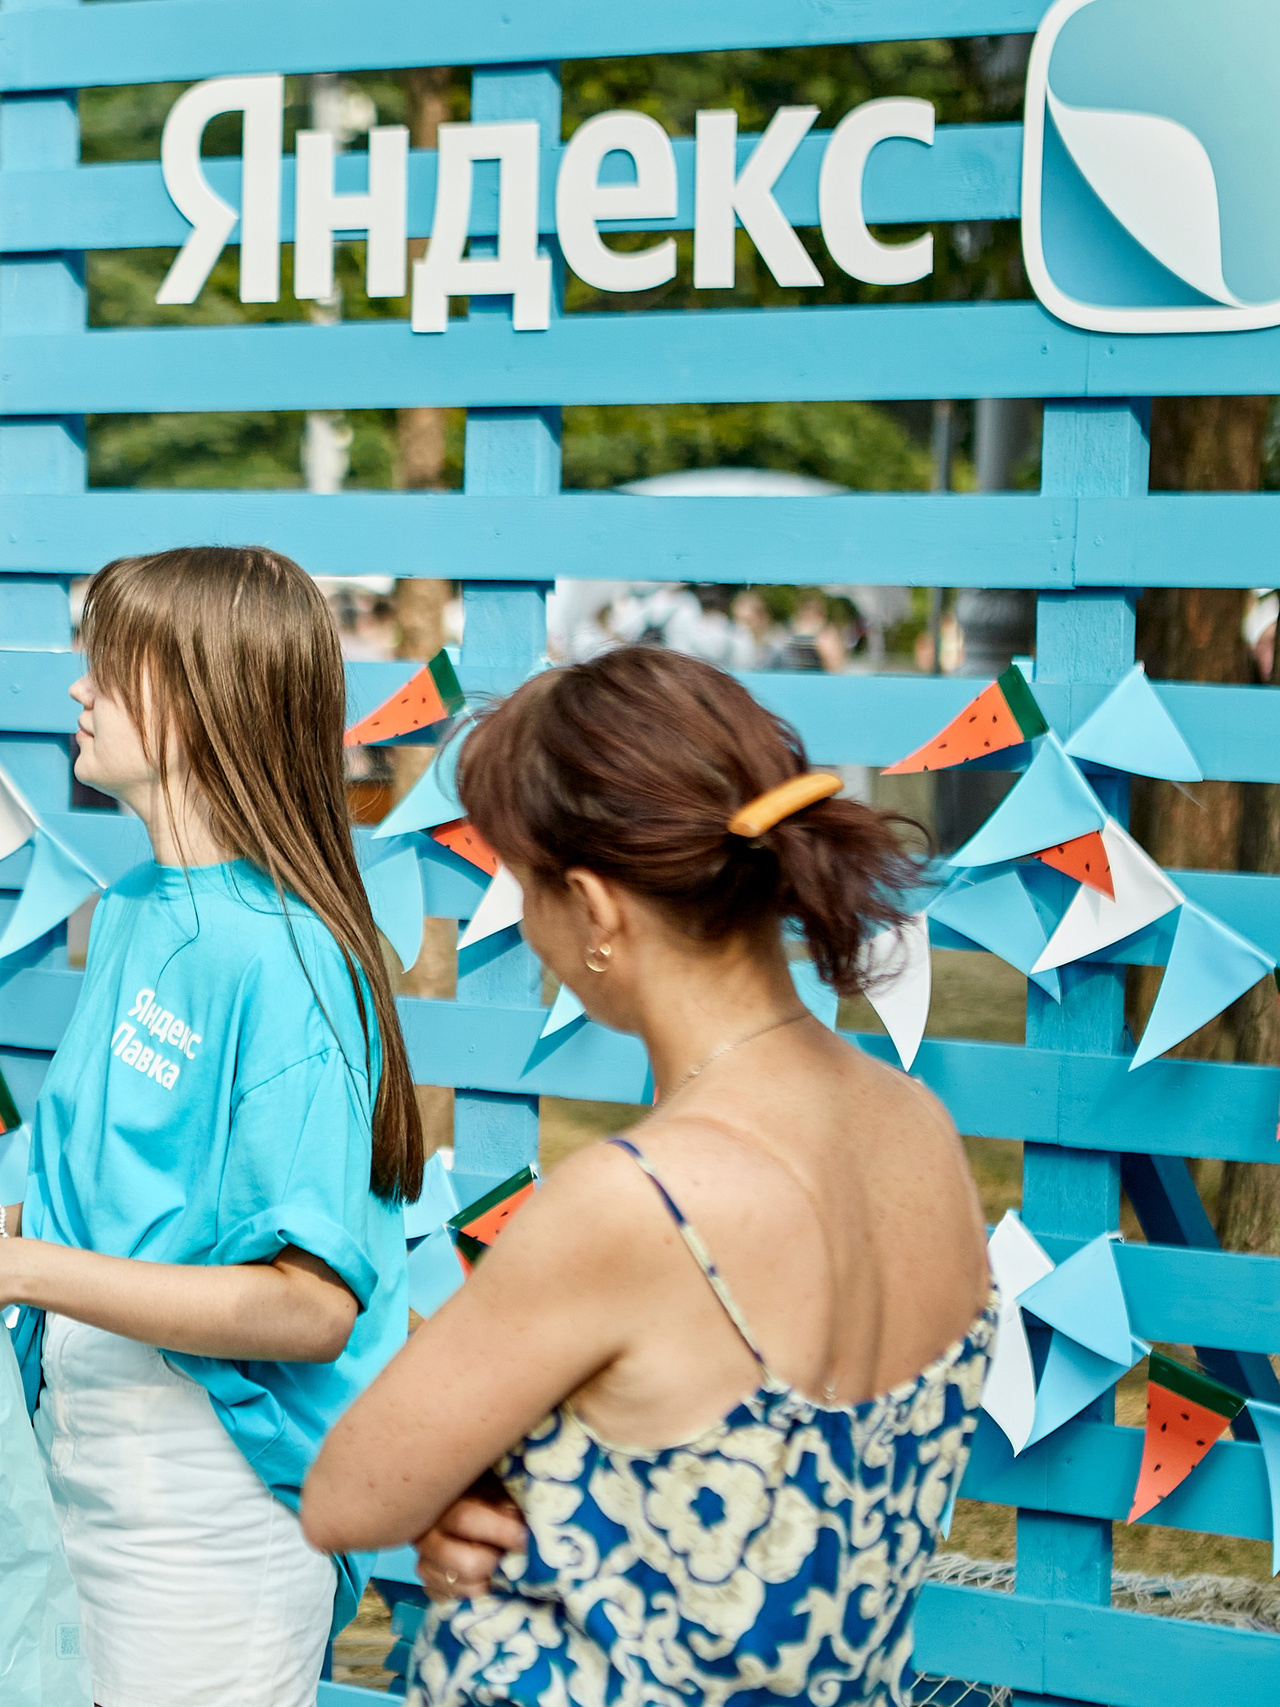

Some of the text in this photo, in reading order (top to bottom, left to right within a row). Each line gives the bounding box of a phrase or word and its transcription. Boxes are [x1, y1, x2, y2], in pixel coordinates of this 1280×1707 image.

[156, 74, 936, 333] Яндекс
[110, 1021, 181, 1091] Лавка
[127, 988, 202, 1060] Яндекс
